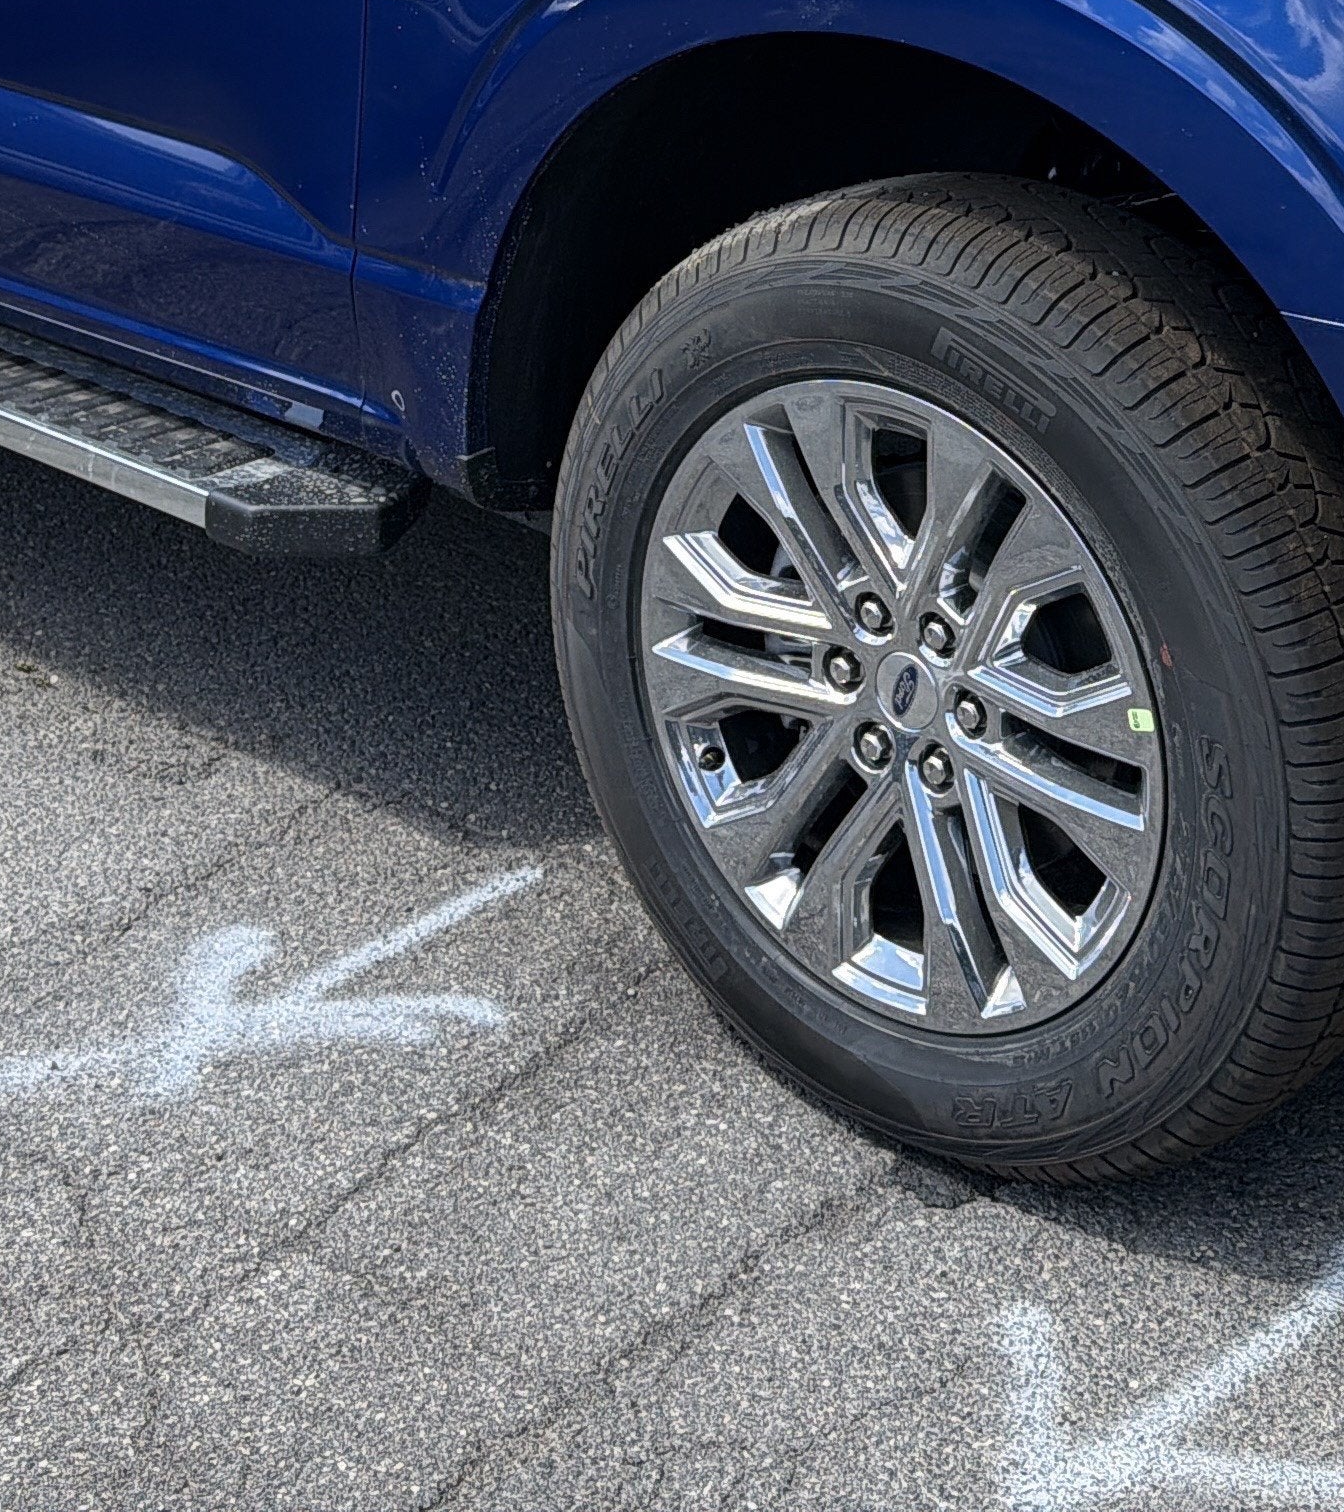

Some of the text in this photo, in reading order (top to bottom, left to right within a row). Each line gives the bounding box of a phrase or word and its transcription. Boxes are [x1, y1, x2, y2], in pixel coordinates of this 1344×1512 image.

[931, 326, 1057, 435] PIRELLI
[576, 367, 667, 602] PIRELLI
[895, 671, 915, 711] Ford
[953, 734, 1234, 1129] SCORPION ATR
